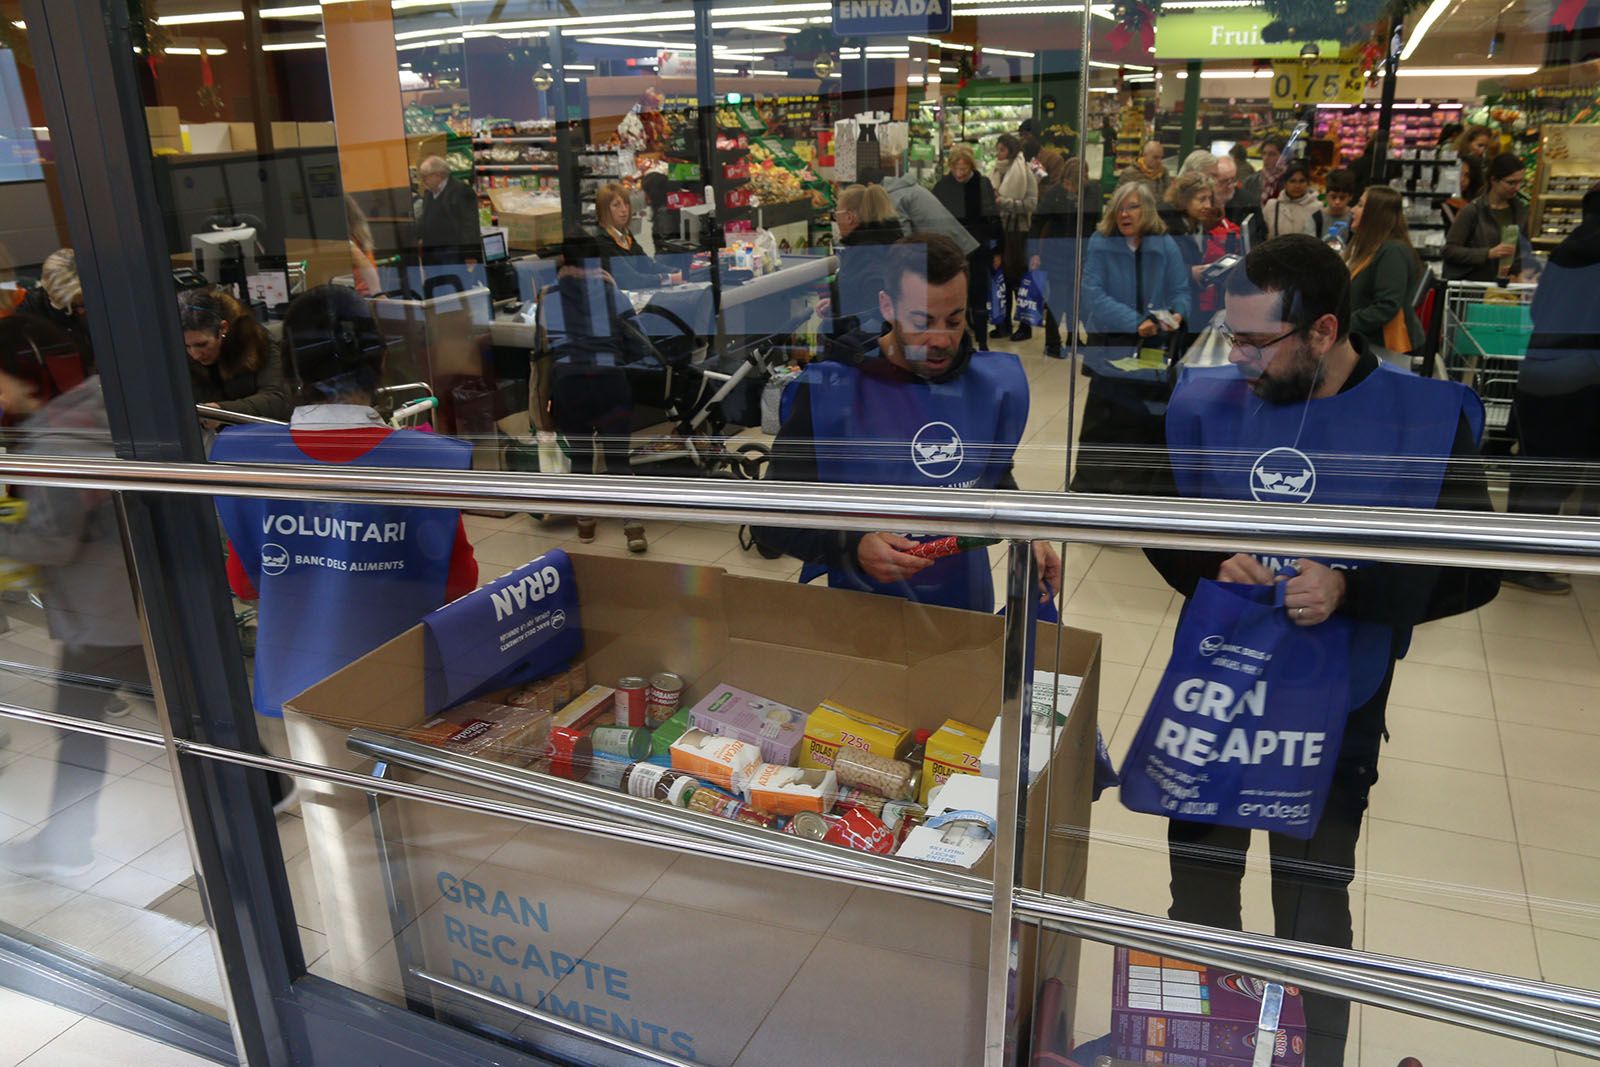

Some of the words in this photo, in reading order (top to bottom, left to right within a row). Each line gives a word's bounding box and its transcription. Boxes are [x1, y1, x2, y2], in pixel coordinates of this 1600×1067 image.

[839, 0, 943, 18] ENTRADA
[1210, 25, 1281, 46] Frui
[262, 514, 407, 543] VOLUNTARI
[295, 555, 325, 567] BANC
[327, 558, 347, 571] DELS
[350, 560, 405, 572] ALIMENTS
[490, 566, 560, 622] GRAN
[810, 740, 833, 758] BOLAS
[1154, 719, 1326, 767] REAPTE
[932, 762, 960, 776] BOLA
[1238, 801, 1310, 819] endesa
[436, 871, 550, 934] GRAN
[444, 914, 631, 1001] RECAPTE
[453, 958, 697, 1060] D'ALIMENTS
[1275, 1028, 1289, 1058] ARROZ
